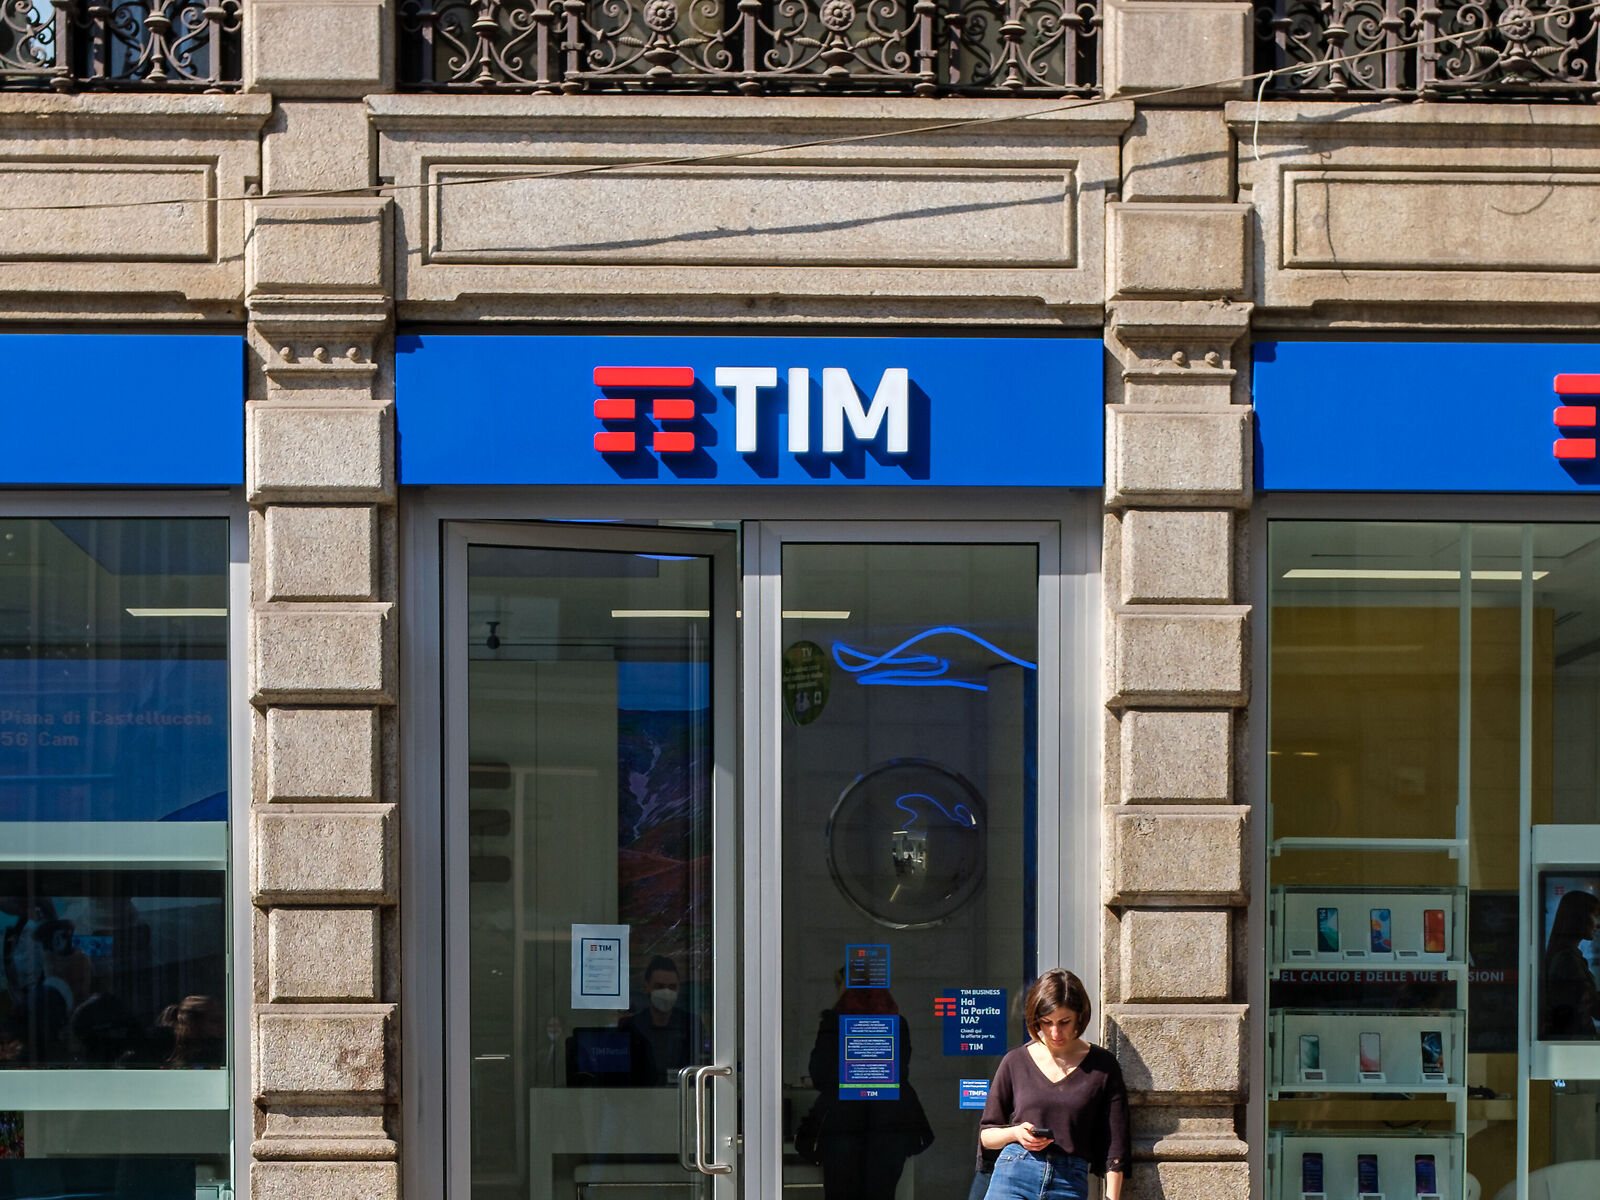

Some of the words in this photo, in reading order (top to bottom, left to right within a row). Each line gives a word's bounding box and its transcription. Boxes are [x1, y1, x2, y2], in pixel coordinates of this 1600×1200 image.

[715, 366, 909, 453] TIM
[1, 710, 54, 725] Piana
[62, 710, 80, 725] di
[91, 710, 213, 725] Castelluccio
[1, 732, 28, 747] 5G
[39, 732, 79, 747] Cam
[1301, 971, 1350, 982] CALCIO
[1354, 971, 1361, 982] E
[1367, 971, 1406, 982] DELLE
[1413, 971, 1437, 982] TUE
[960, 998, 976, 1006] Hai
[960, 1007, 969, 1015] la
[971, 1007, 1000, 1015] Partita
[960, 1016, 980, 1024] IVA?
[969, 1043, 984, 1051] TIM
